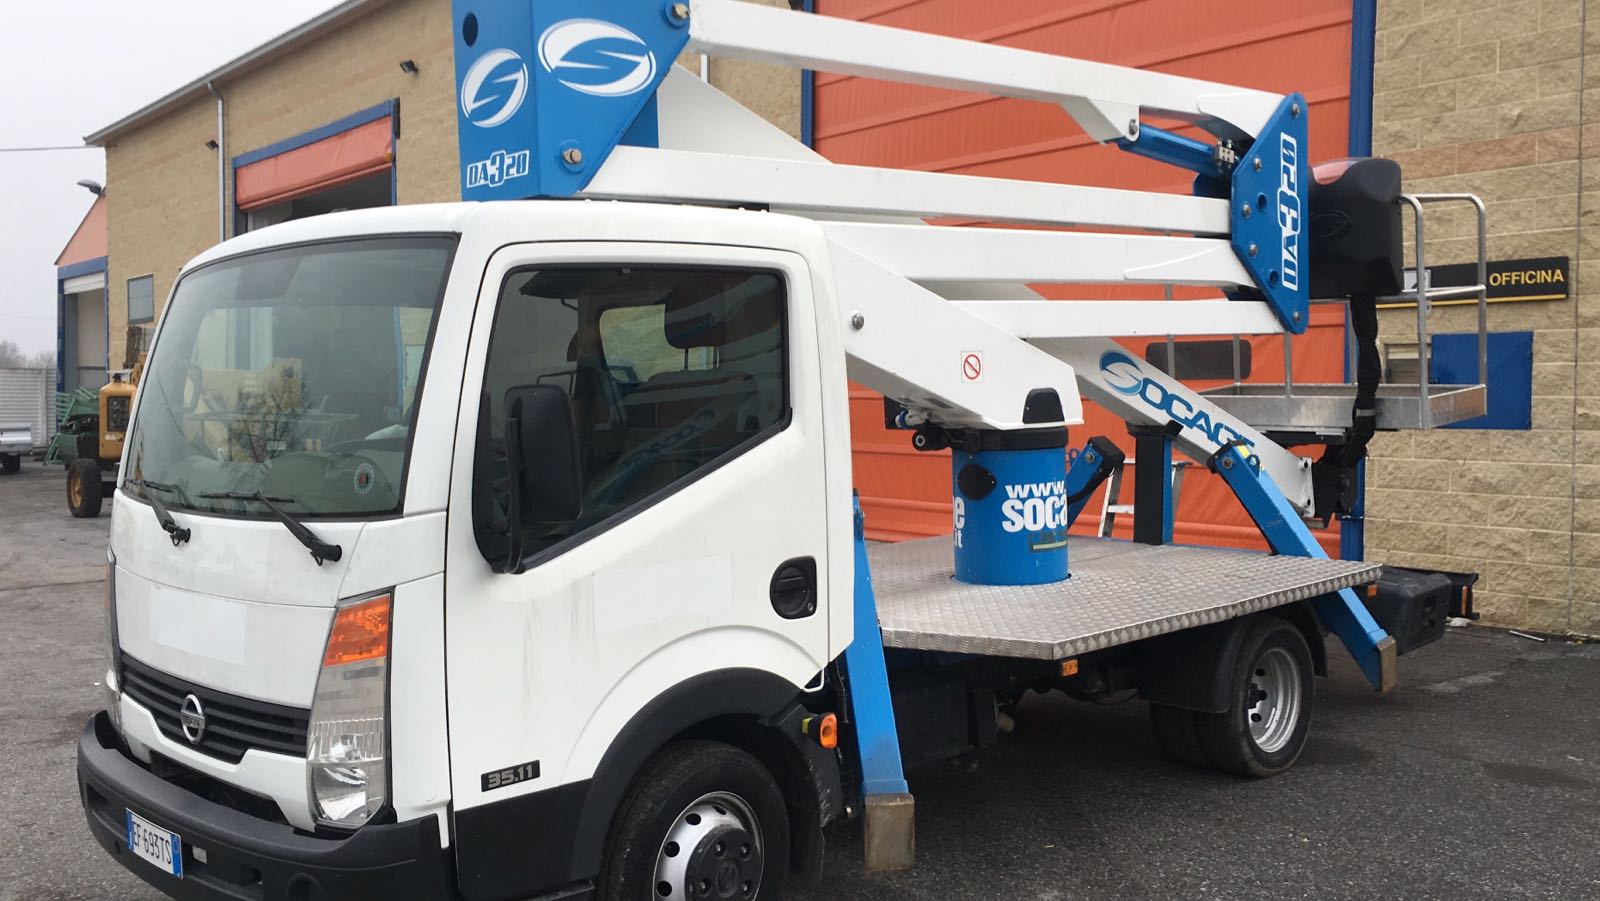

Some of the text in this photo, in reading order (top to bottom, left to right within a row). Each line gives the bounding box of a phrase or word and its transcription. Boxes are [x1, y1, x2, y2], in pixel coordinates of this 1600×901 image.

[466, 149, 529, 188] DA320
[1277, 132, 1300, 291] DA320
[1489, 269, 1564, 287] OFFICINA
[488, 764, 533, 788] 35.11
